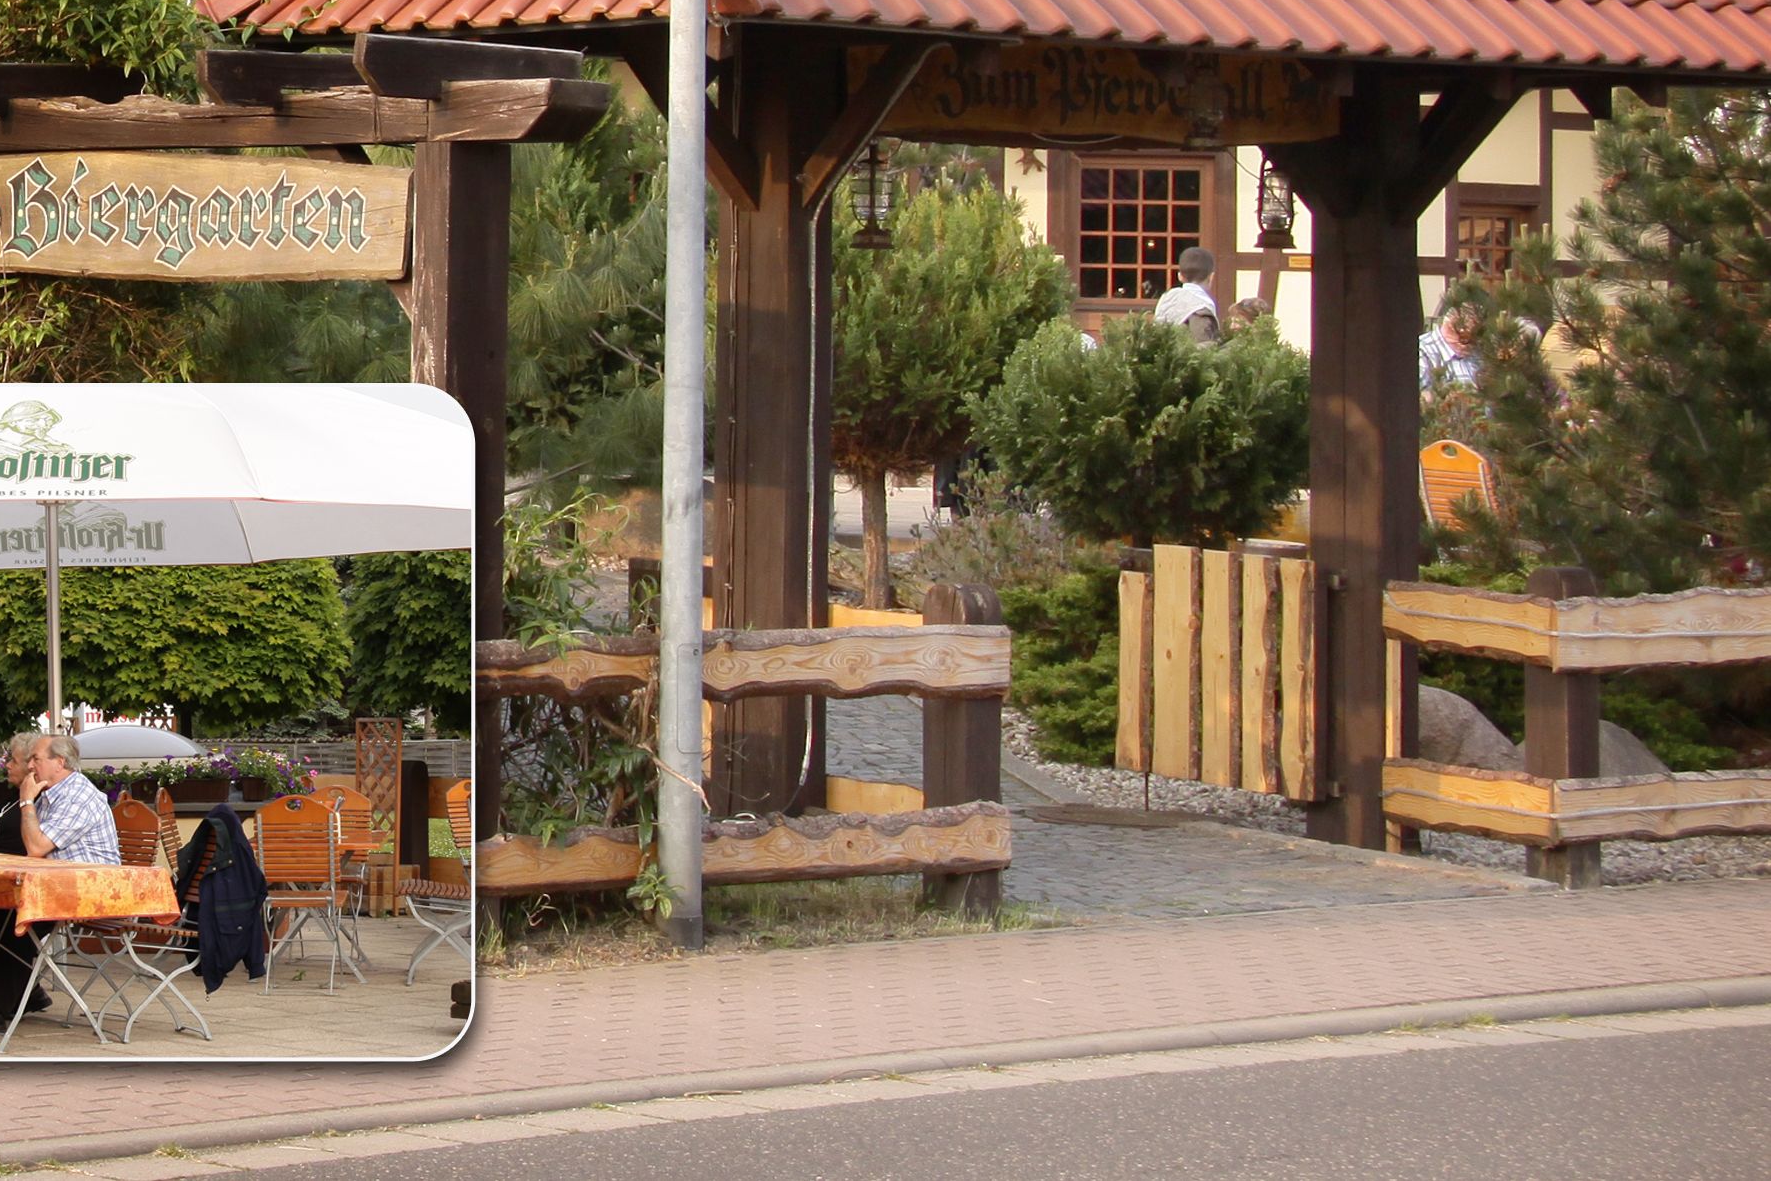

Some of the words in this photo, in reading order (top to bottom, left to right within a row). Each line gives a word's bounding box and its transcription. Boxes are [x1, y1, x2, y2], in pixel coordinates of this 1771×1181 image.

[934, 47, 1039, 118] Zum
[3, 157, 372, 271] Biergarten
[37, 489, 108, 497] PILSNER
